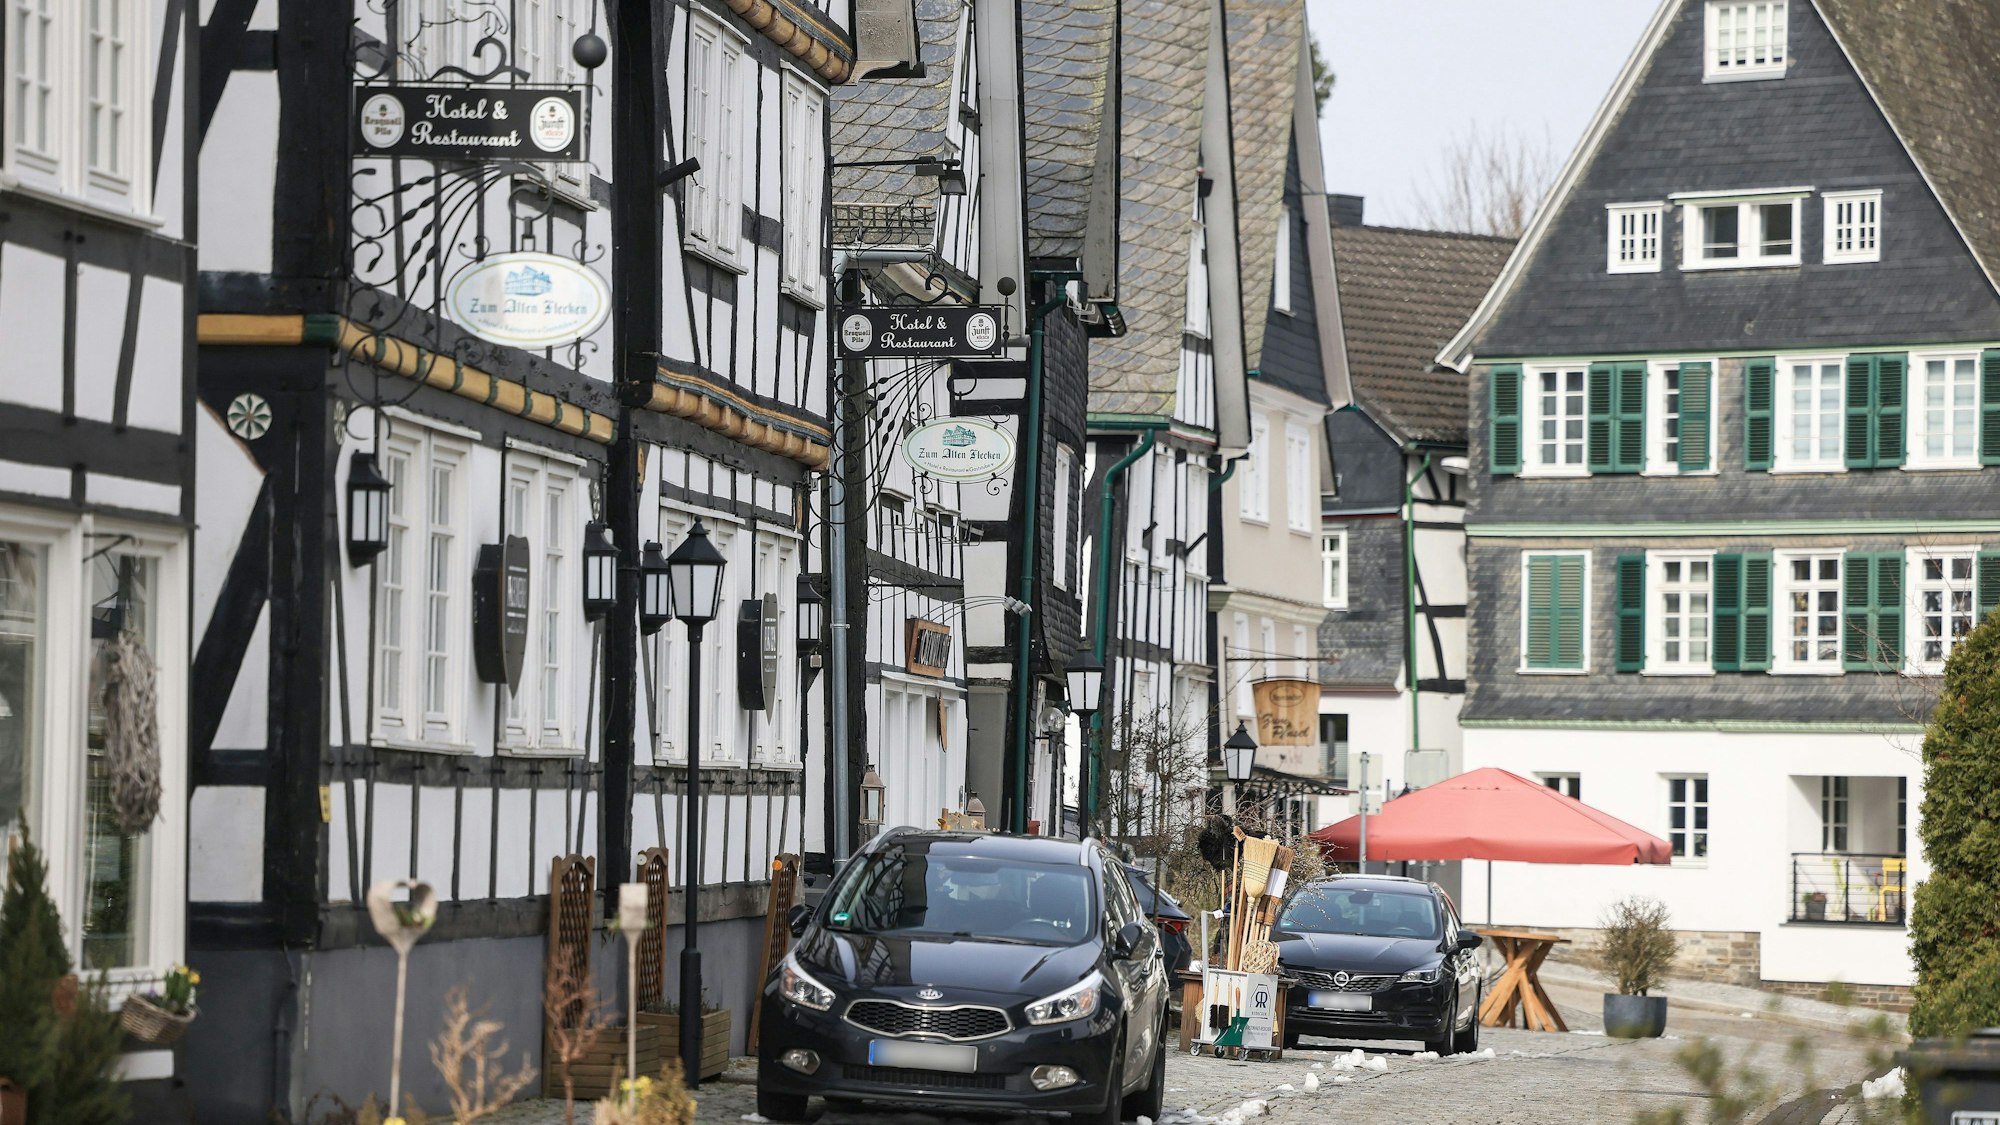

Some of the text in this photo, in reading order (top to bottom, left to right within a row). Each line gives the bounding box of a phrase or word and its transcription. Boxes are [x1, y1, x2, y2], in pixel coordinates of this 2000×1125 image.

[425, 94, 509, 120] Hotel &
[411, 120, 522, 147] Restaurant
[470, 298, 498, 313] Zum
[503, 298, 538, 314] Alten
[890, 313, 948, 330] Hotel &
[880, 331, 957, 348] Restaurant
[918, 447, 1001, 460] Zum Alten Flecken
